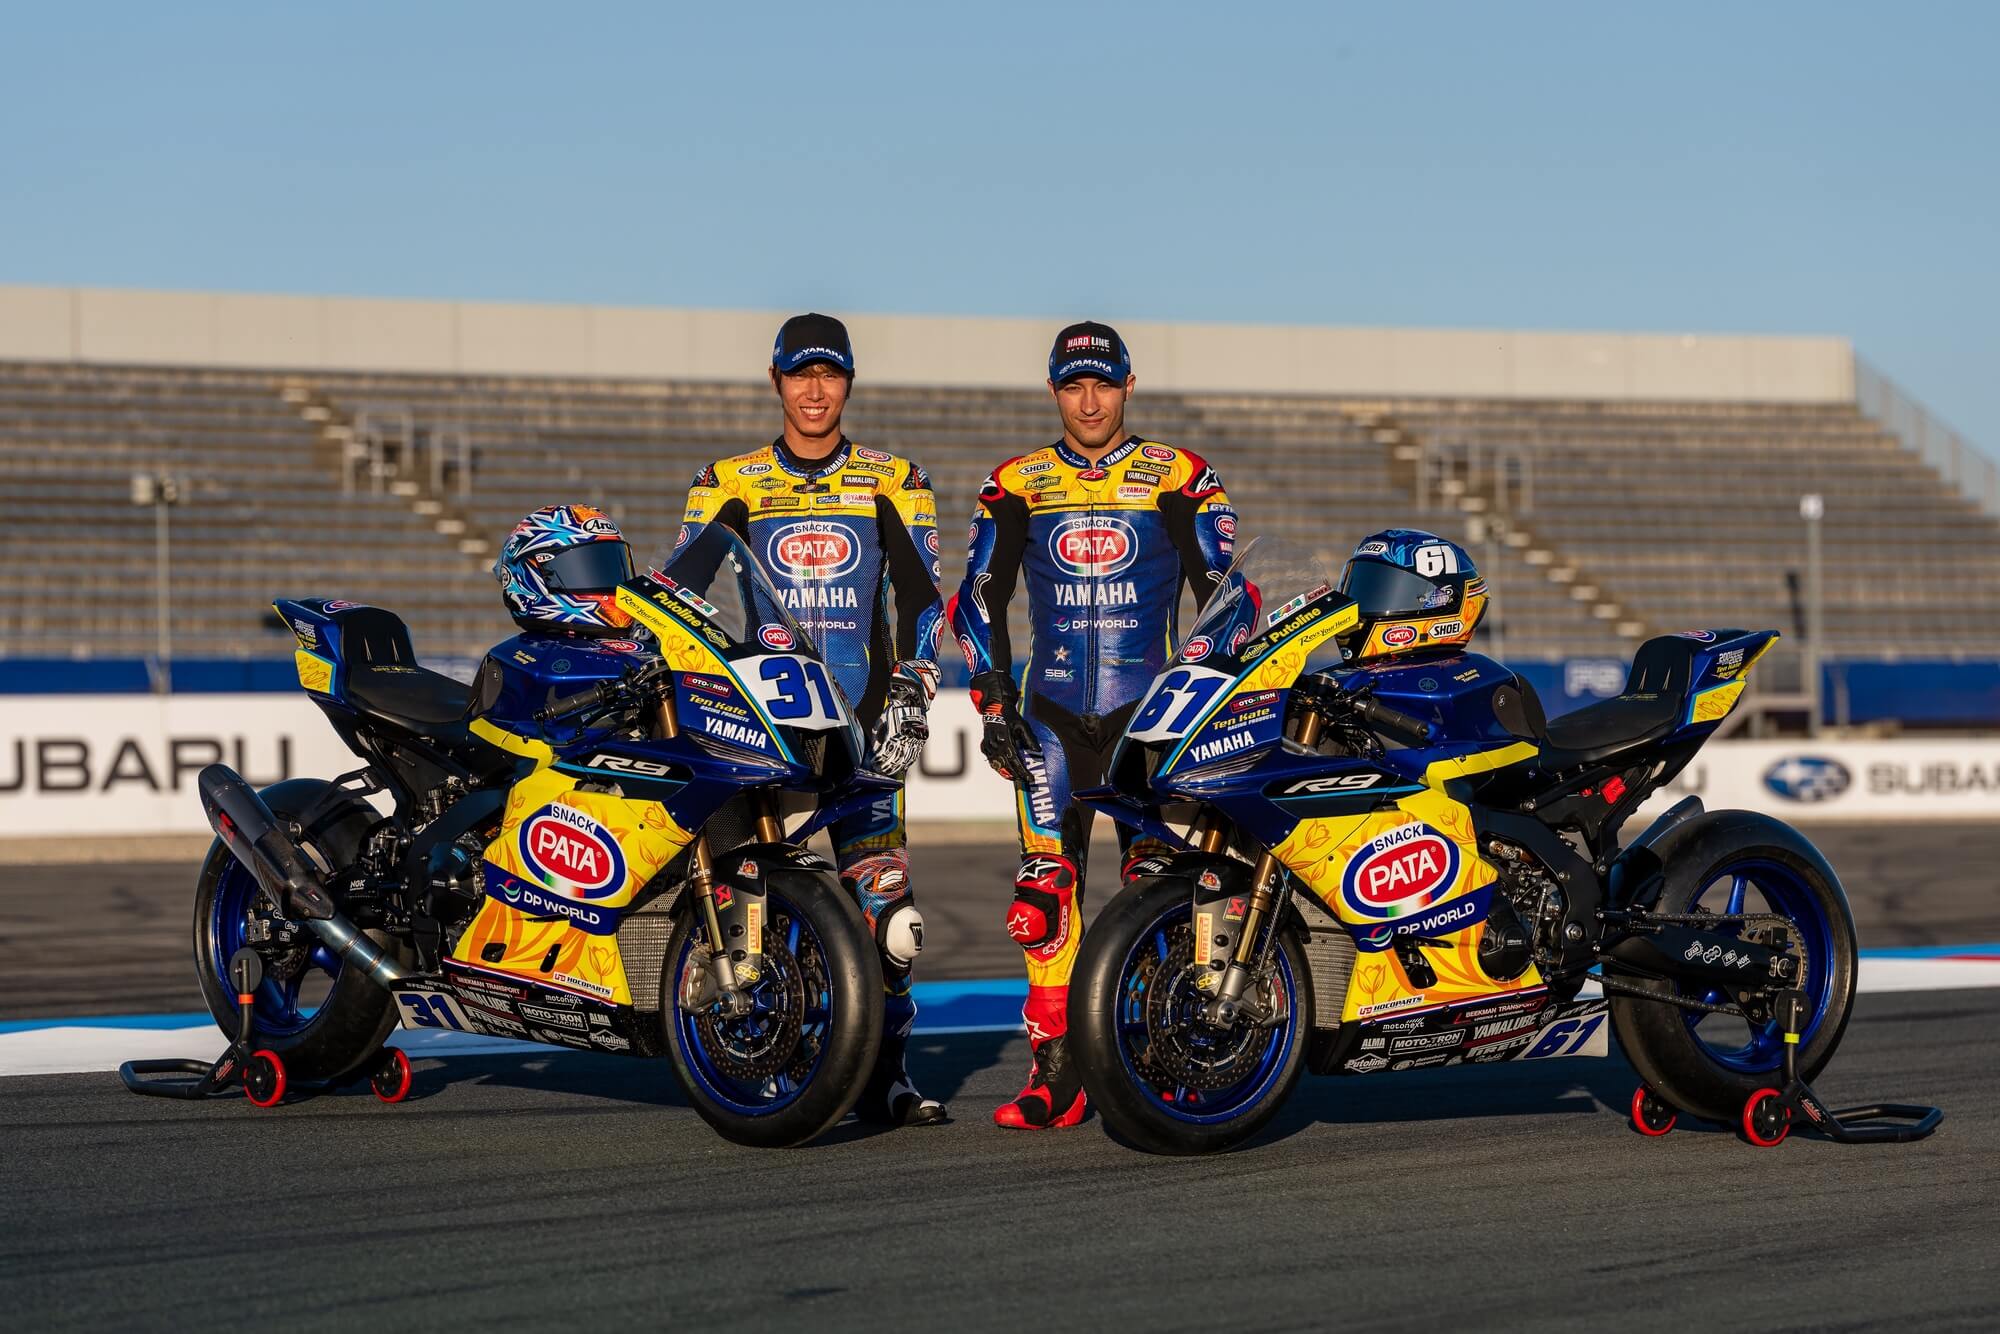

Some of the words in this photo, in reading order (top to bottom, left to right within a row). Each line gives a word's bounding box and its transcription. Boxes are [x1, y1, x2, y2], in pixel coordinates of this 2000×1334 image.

[1068, 337, 1089, 348] HARD
[1091, 336, 1110, 348] LINE
[802, 346, 844, 362] YAMAHA
[1070, 359, 1112, 374] YAMAHA
[1016, 453, 1049, 466] PIRELLI
[1103, 441, 1137, 465] YAMAHA
[1147, 447, 1169, 459] PATA
[743, 464, 768, 473] Arai
[823, 453, 848, 476] YAMAHA
[1023, 462, 1051, 474] SHOEI
[752, 478, 786, 489] Putoline
[844, 475, 877, 485] YAMALUBE
[1026, 477, 1061, 489] Putoline
[1126, 471, 1159, 483] YAMALUBE
[1126, 486, 1151, 494] YAMAHA
[795, 524, 830, 533] SNACK
[1073, 518, 1112, 529] SNACK
[787, 540, 840, 560] PATA
[1065, 535, 1119, 557] PATA
[1415, 545, 1458, 578] 61
[778, 587, 858, 609] YAMAHA
[1054, 582, 1138, 606] YAMAHA
[652, 591, 702, 627] Putoline
[817, 620, 856, 630] WORLD
[1072, 619, 1088, 629] DP
[1091, 618, 1139, 629] WORLD
[1268, 607, 1322, 643] Putoline
[1433, 622, 1461, 636] SHOEI
[766, 632, 790, 642] PATA
[1389, 630, 1410, 641] PATA
[1185, 643, 1205, 655] PATA
[1044, 668, 1076, 678] SBK
[759, 655, 840, 722] 31
[689, 693, 712, 707] Ten
[715, 701, 748, 717] Kate
[1129, 670, 1230, 734] 61
[1212, 717, 1236, 730] Ten
[1238, 707, 1270, 722] Kate
[705, 716, 767, 750] YAMAHA
[1190, 730, 1255, 763] YAMAHA
[587, 754, 672, 777] R9
[1284, 773, 1383, 794] R9
[1867, 762, 2000, 796] SUBA
[1024, 750, 1056, 826] AMAHA
[552, 805, 596, 836] SNACK
[1374, 824, 1422, 852] SNACK
[537, 826, 599, 878] PATA
[1368, 848, 1439, 897] PATA
[349, 879, 366, 889] NGK
[523, 890, 542, 906] DP
[543, 899, 601, 926] WORLD
[1397, 922, 1421, 936] DP
[1422, 902, 1476, 932] WORLD
[749, 908, 759, 949] PIRELLI
[1198, 916, 1210, 962] PIRELLI
[1736, 954, 1751, 967] NGK
[456, 976, 485, 988] BEEKMAN
[485, 981, 520, 994] TRANSPORT
[566, 976, 611, 995] HOCOPARTS
[545, 994, 583, 1005] motonext
[1373, 996, 1423, 1011] HOCOPARTS
[399, 993, 465, 1031] 31
[522, 1006, 582, 1023] MOTO-TRON
[1465, 1006, 1497, 1018] BEEKMAN
[1498, 1000, 1537, 1012] TRANSPORT
[553, 1019, 584, 1028] RACING
[589, 1012, 611, 1025] ALMA
[1382, 1021, 1425, 1031] motonext
[1473, 1011, 1541, 1040] YAMALUBE
[589, 1032, 631, 1049] Putoline
[1361, 1037, 1386, 1049] ALMA
[1394, 1032, 1461, 1049] MOTO-TRON
[1425, 1039, 1458, 1049] RACING
[1523, 1013, 1607, 1059] 61
[1344, 1057, 1389, 1070] Putoline
